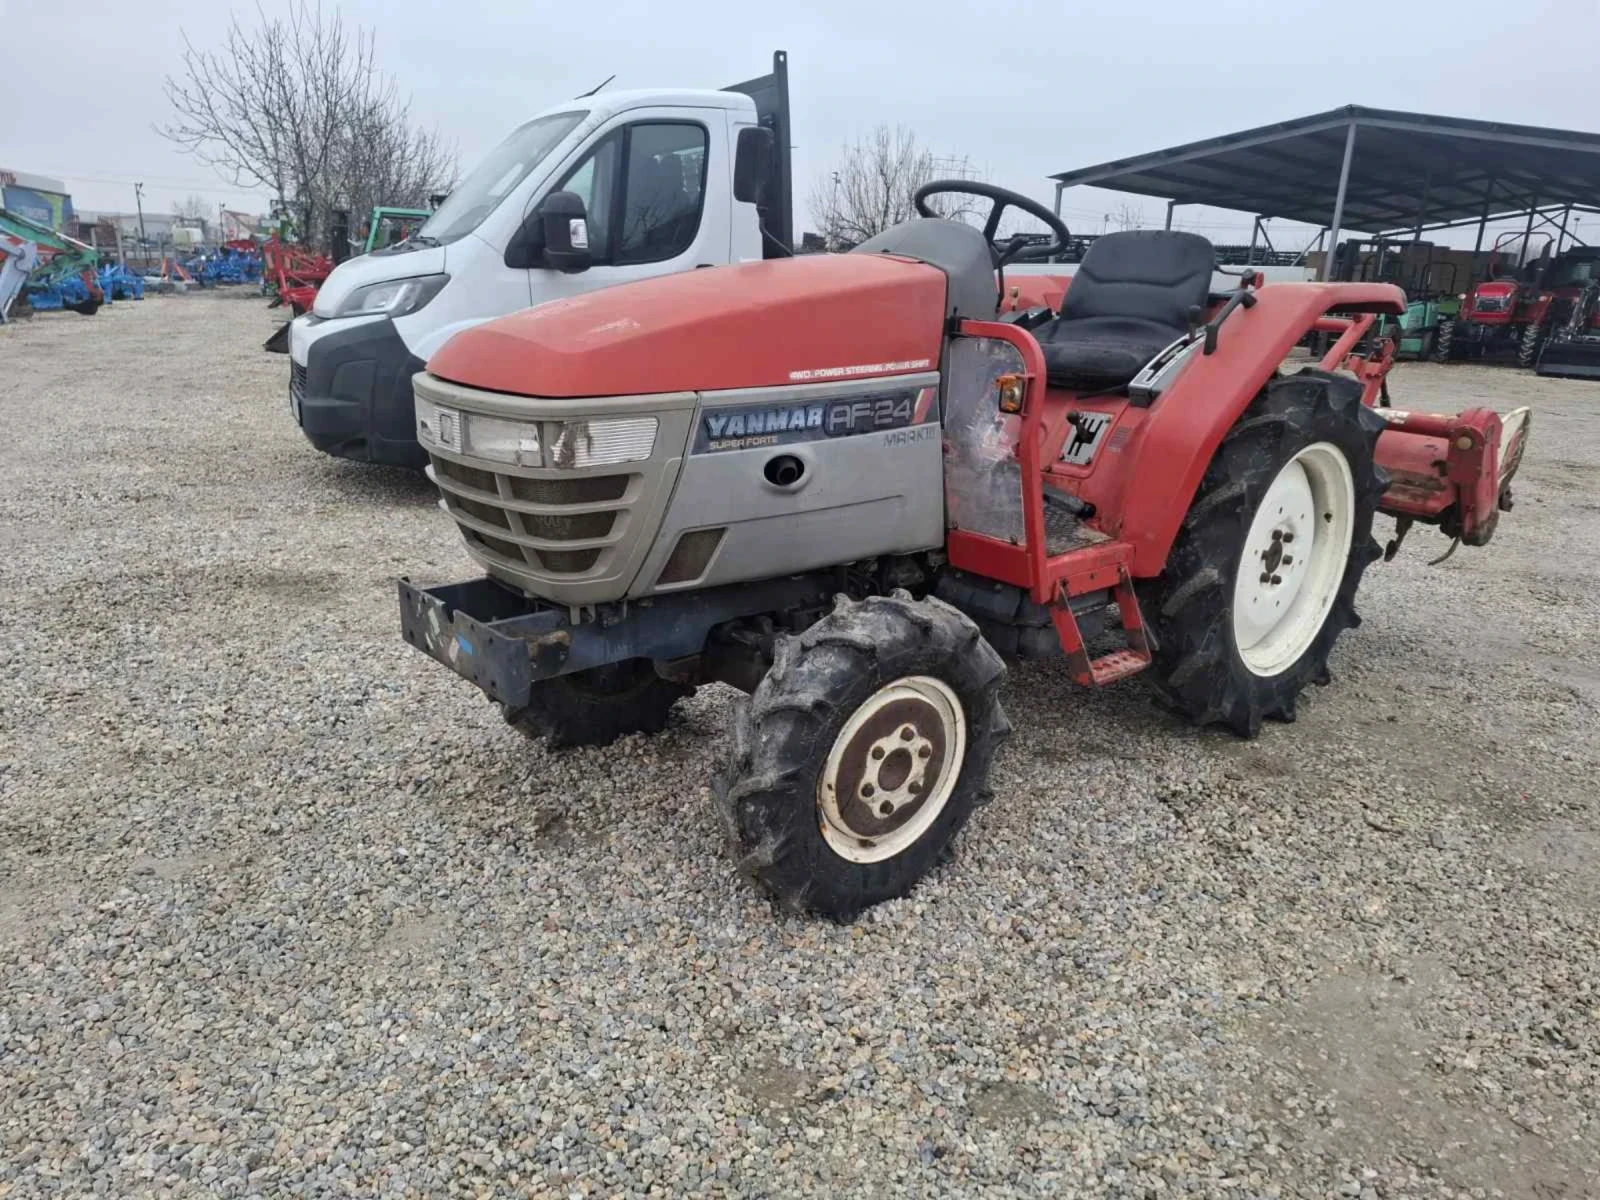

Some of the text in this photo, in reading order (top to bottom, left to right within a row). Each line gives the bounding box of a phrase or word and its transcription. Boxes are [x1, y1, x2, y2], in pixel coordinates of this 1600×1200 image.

[707, 407, 823, 437] YANMAR
[710, 435, 778, 450] SUPER FORTE
